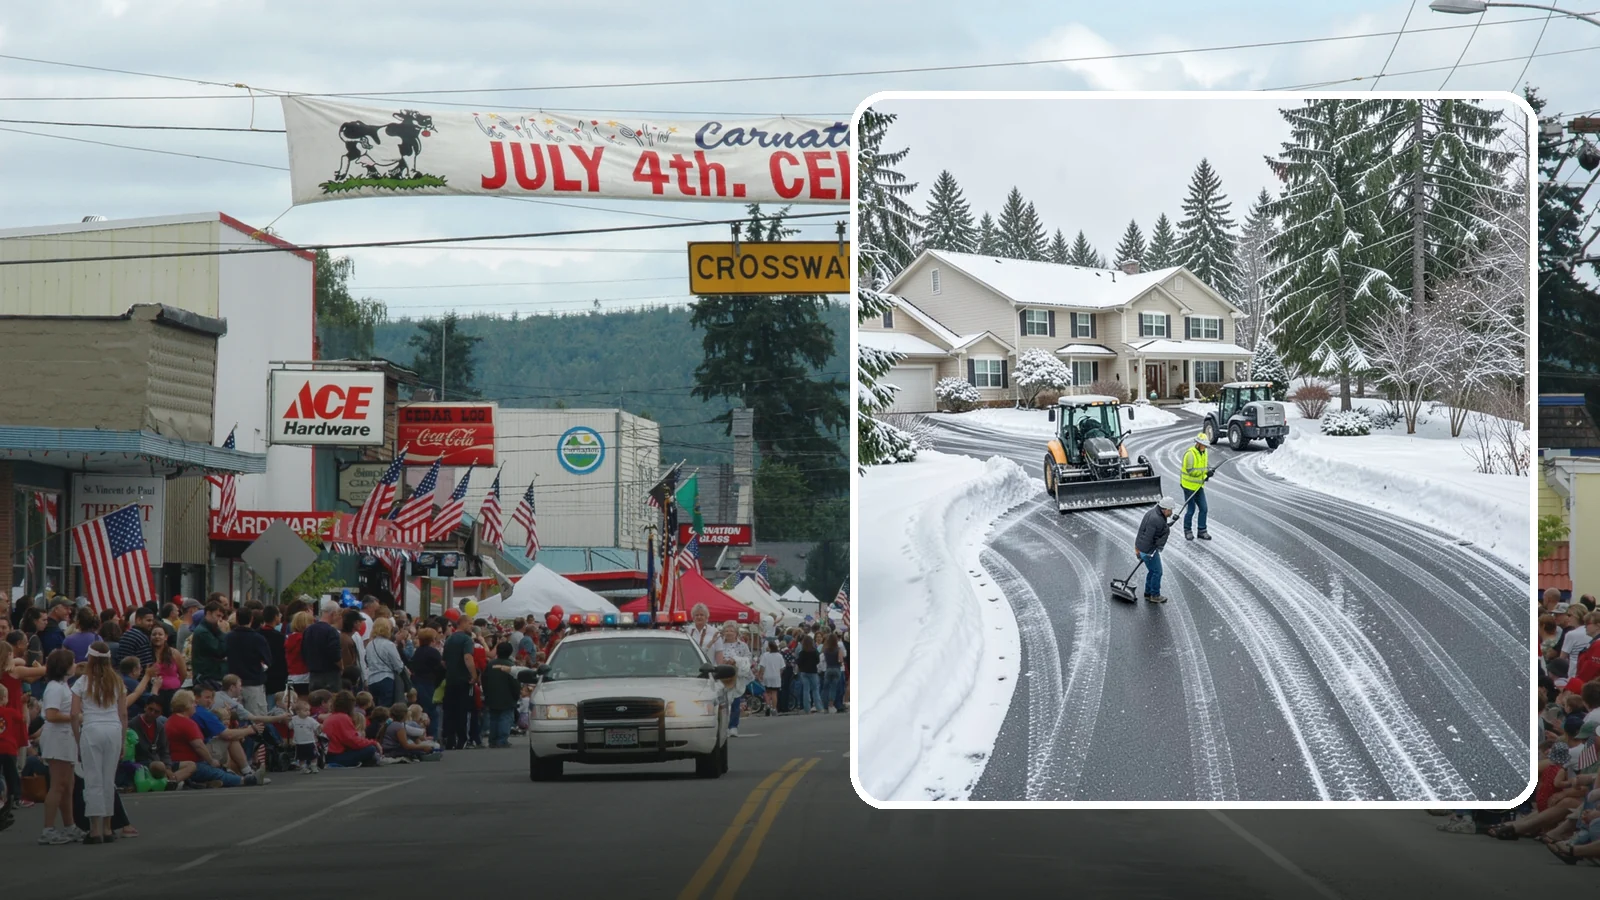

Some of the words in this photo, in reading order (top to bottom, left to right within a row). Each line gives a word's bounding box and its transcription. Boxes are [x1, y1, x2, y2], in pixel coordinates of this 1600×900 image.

[695, 121, 850, 150] Carnat
[481, 140, 605, 192] JULY
[632, 149, 746, 197] 4th.
[697, 254, 850, 280] CROSSWA
[283, 380, 373, 420] ACE
[406, 409, 452, 422] CEDAR
[283, 421, 370, 437] Hardware
[416, 428, 477, 446] Coca-Cola
[353, 467, 387, 481] Simpl
[83, 485, 93, 494] St.
[96, 485, 124, 495] Vincent
[126, 486, 136, 494] de
[138, 486, 155, 495] Paul
[213, 516, 330, 535] HARDARE
[688, 527, 741, 535] CRNATION
[699, 535, 730, 543] GLASS
